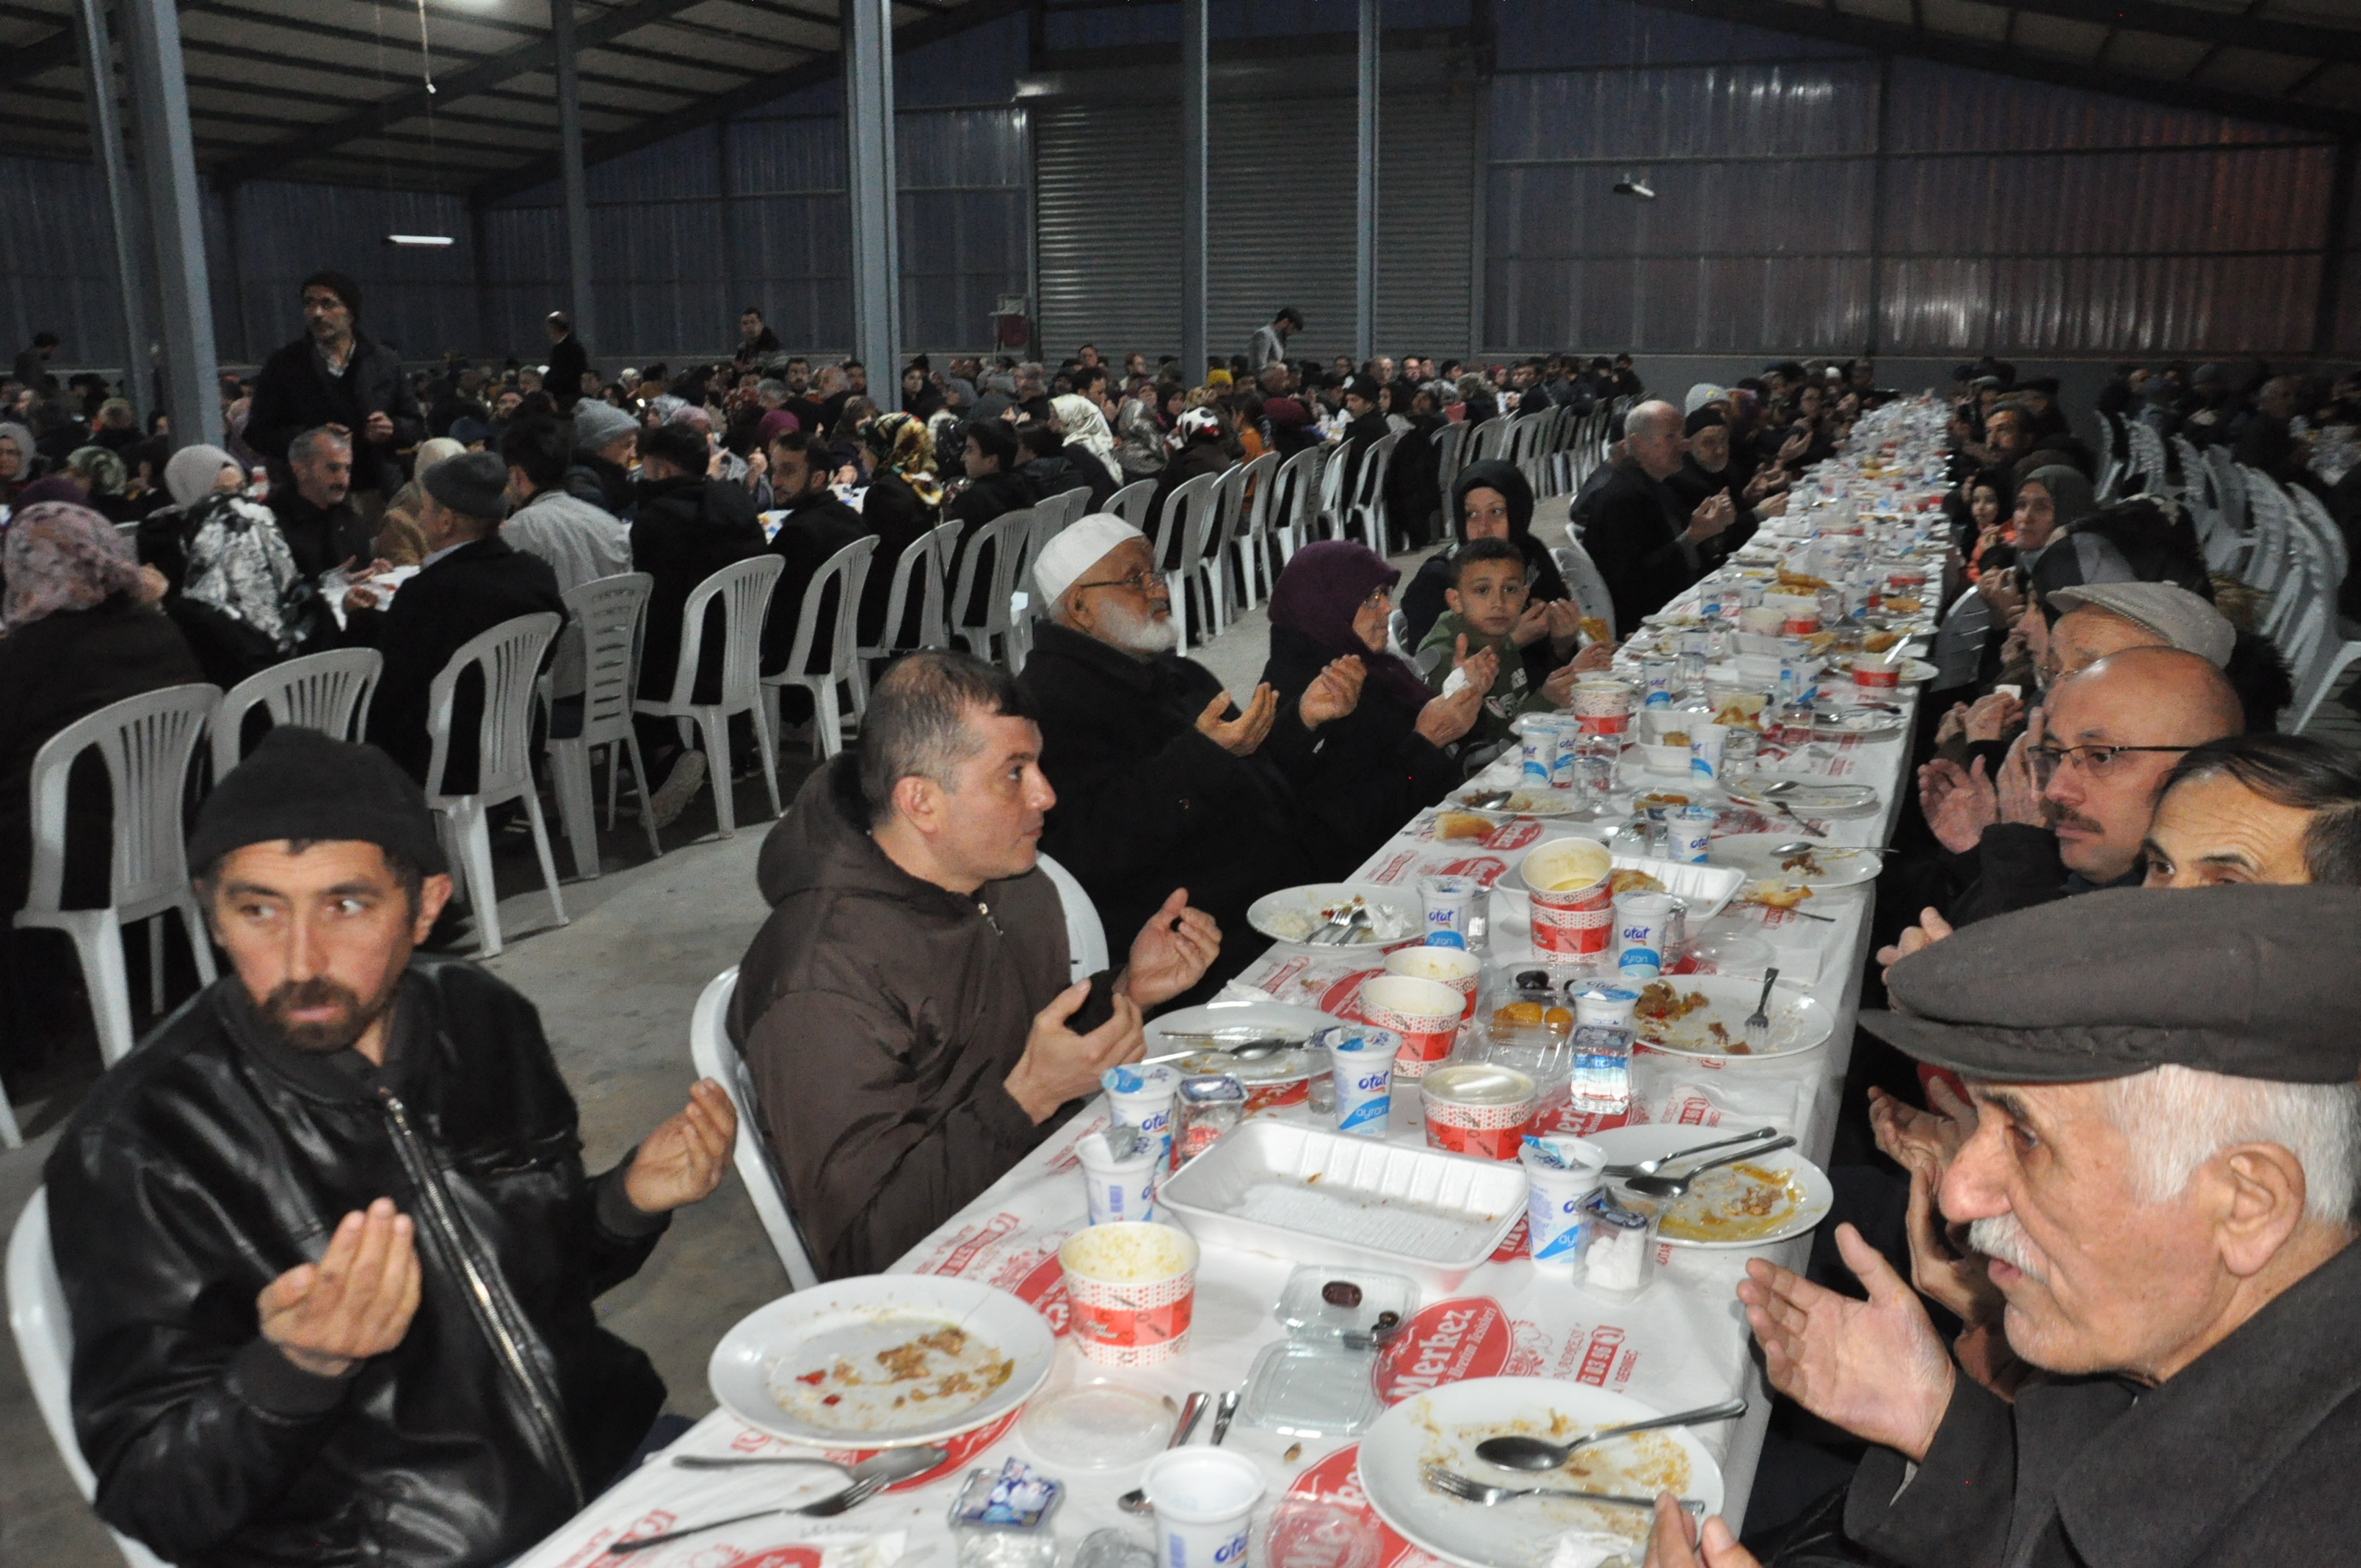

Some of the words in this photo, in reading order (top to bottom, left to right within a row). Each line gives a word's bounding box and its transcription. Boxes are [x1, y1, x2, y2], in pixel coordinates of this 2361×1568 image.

[1429, 910, 1454, 921] otat
[1624, 926, 1650, 940] otat
[1623, 954, 1648, 964] ayran
[1358, 1070, 1388, 1089] otat
[1142, 1108, 1171, 1130] otat
[1356, 1105, 1386, 1119] ayran
[1466, 1306, 1498, 1344] Tesisleri
[1388, 1309, 1477, 1395] Merkez
